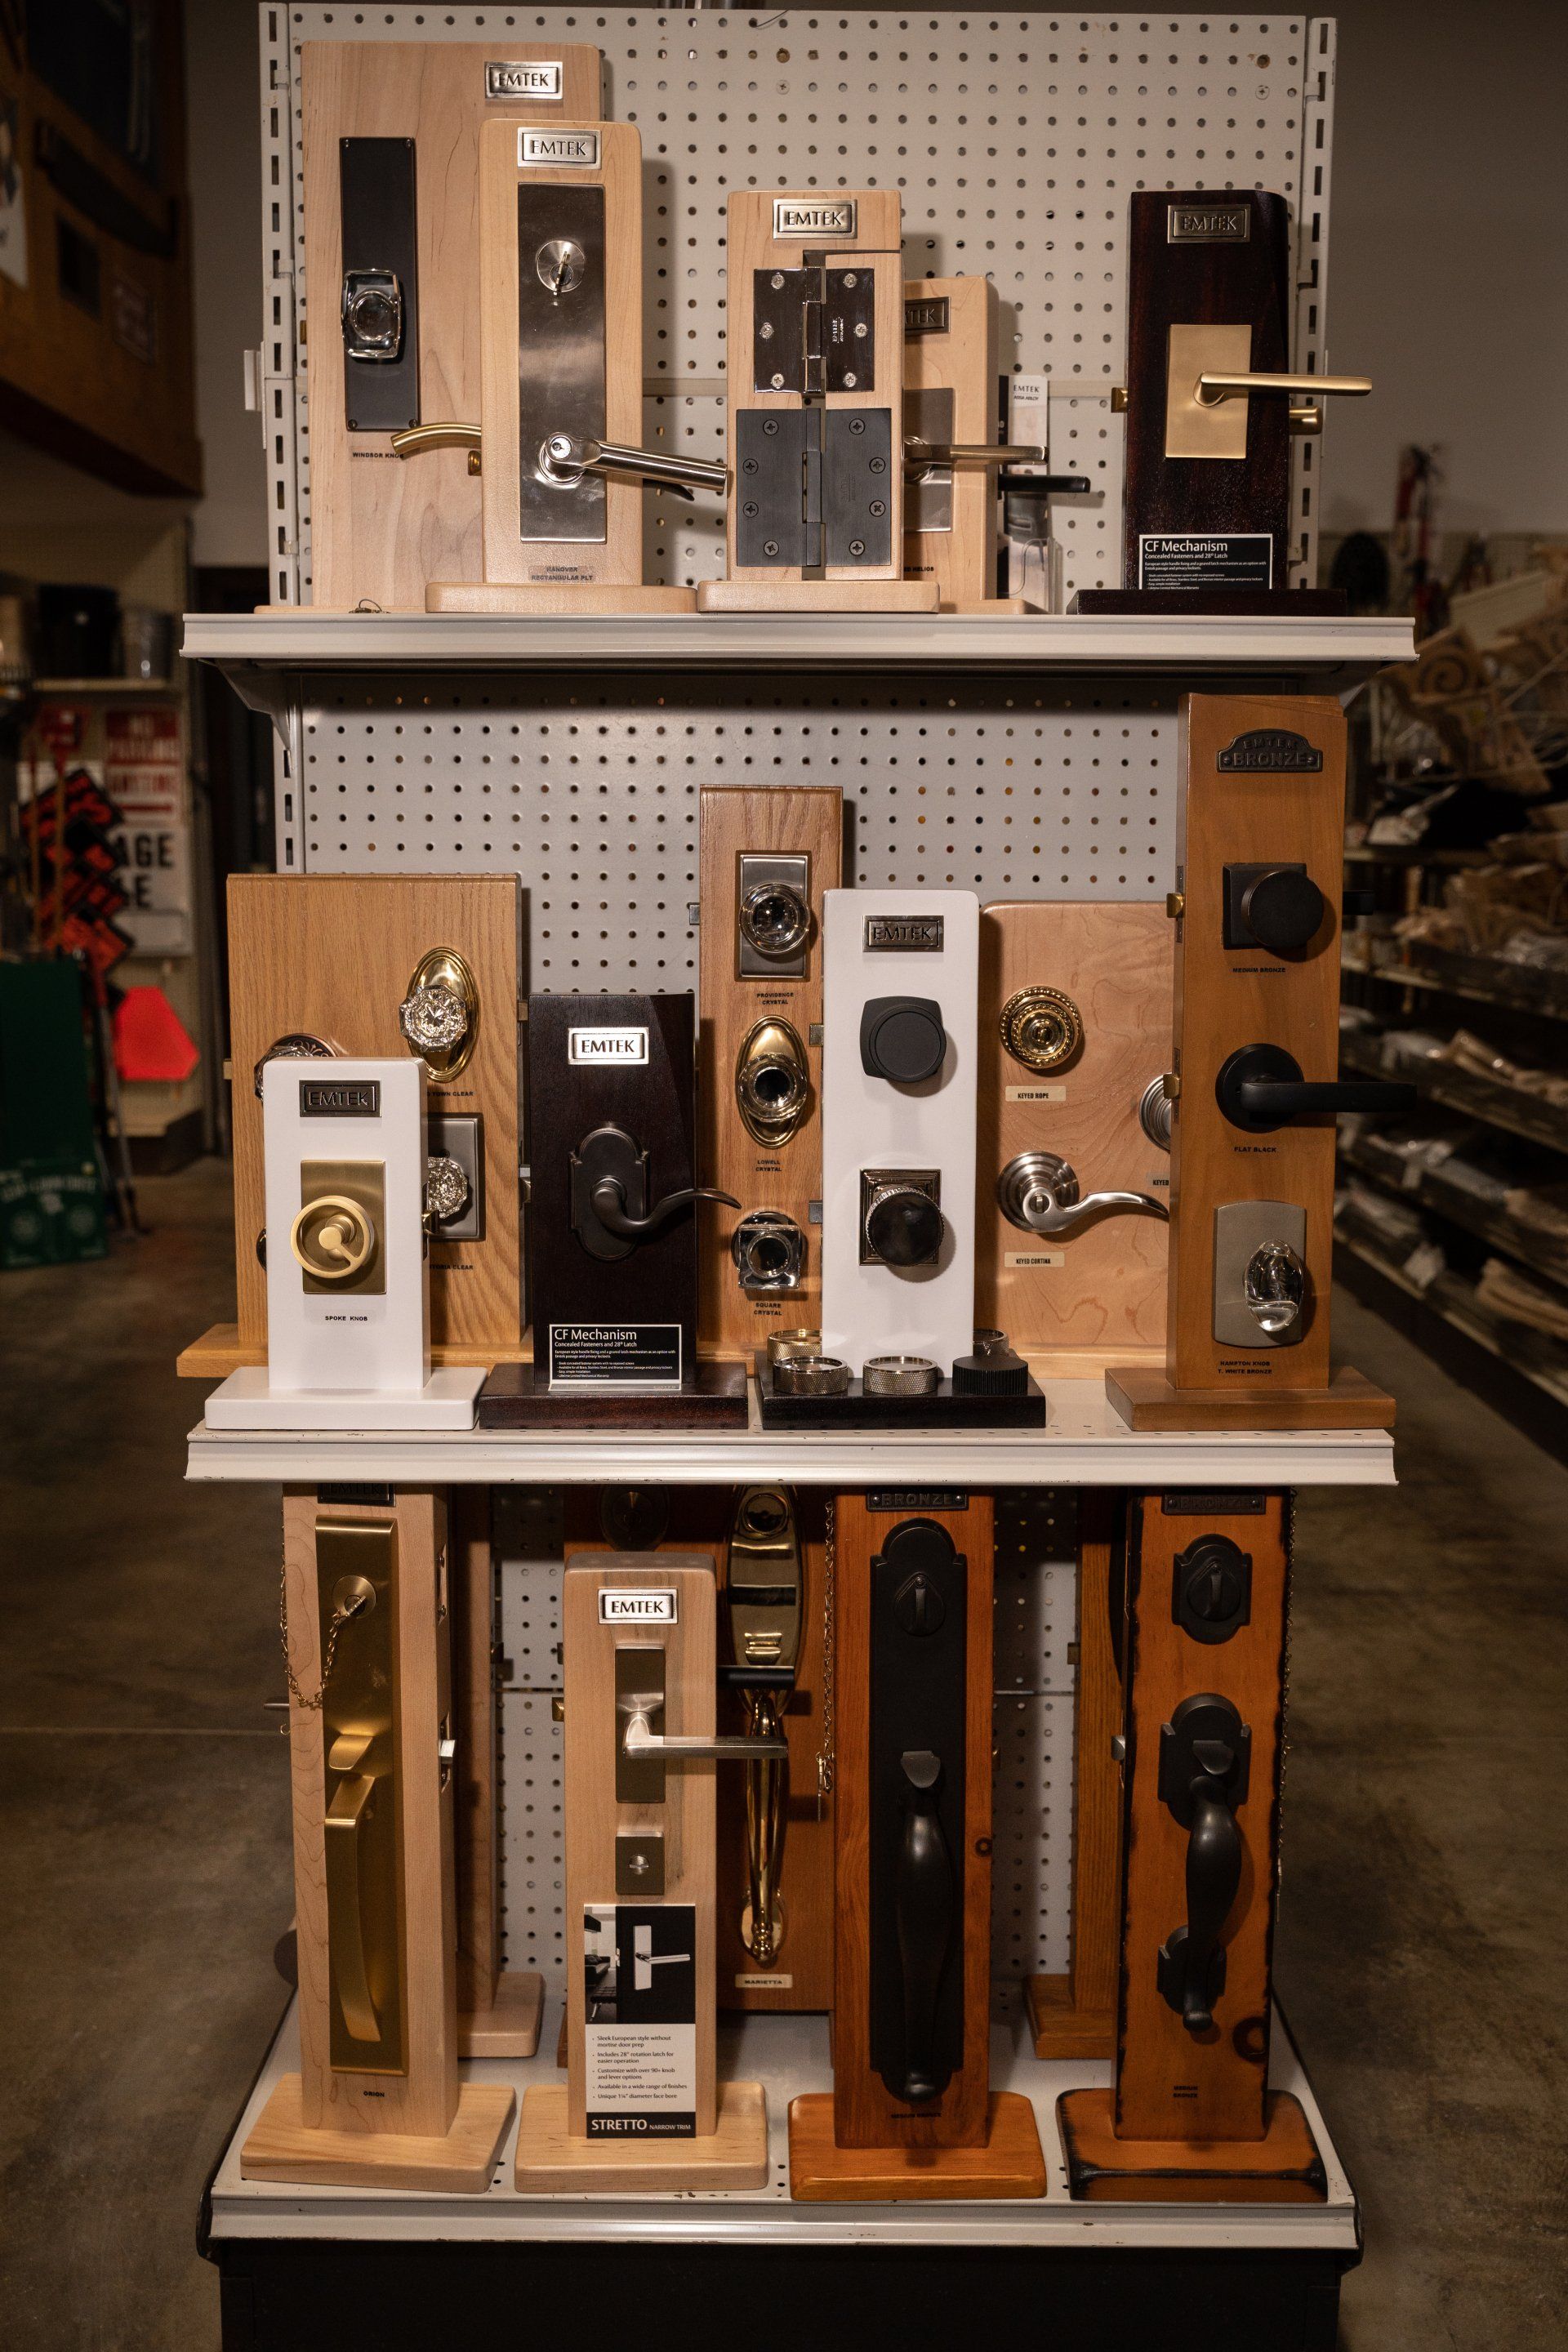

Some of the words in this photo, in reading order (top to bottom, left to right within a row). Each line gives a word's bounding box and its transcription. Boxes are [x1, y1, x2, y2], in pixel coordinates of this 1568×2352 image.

[499, 74, 549, 87] EMTEK
[531, 140, 586, 156] EMTEK
[787, 212, 841, 225] EMTEK
[1183, 216, 1236, 229] EMTEK
[905, 309, 934, 324] TEK
[1145, 541, 1160, 552] CF
[1161, 540, 1227, 552] Mechanism
[1234, 753, 1307, 766] BRONZE
[115, 835, 173, 867] AGE
[874, 928, 933, 941] EMTEK
[581, 1040, 635, 1053] EMTEK
[309, 1092, 368, 1106] EMTEK
[555, 1330, 568, 1339] CF
[572, 1328, 637, 1339] Mechanism
[882, 1494, 954, 1505] BRONZE
[612, 1601, 663, 1614] EMTEK
[591, 2119, 647, 2130] STRETTO
